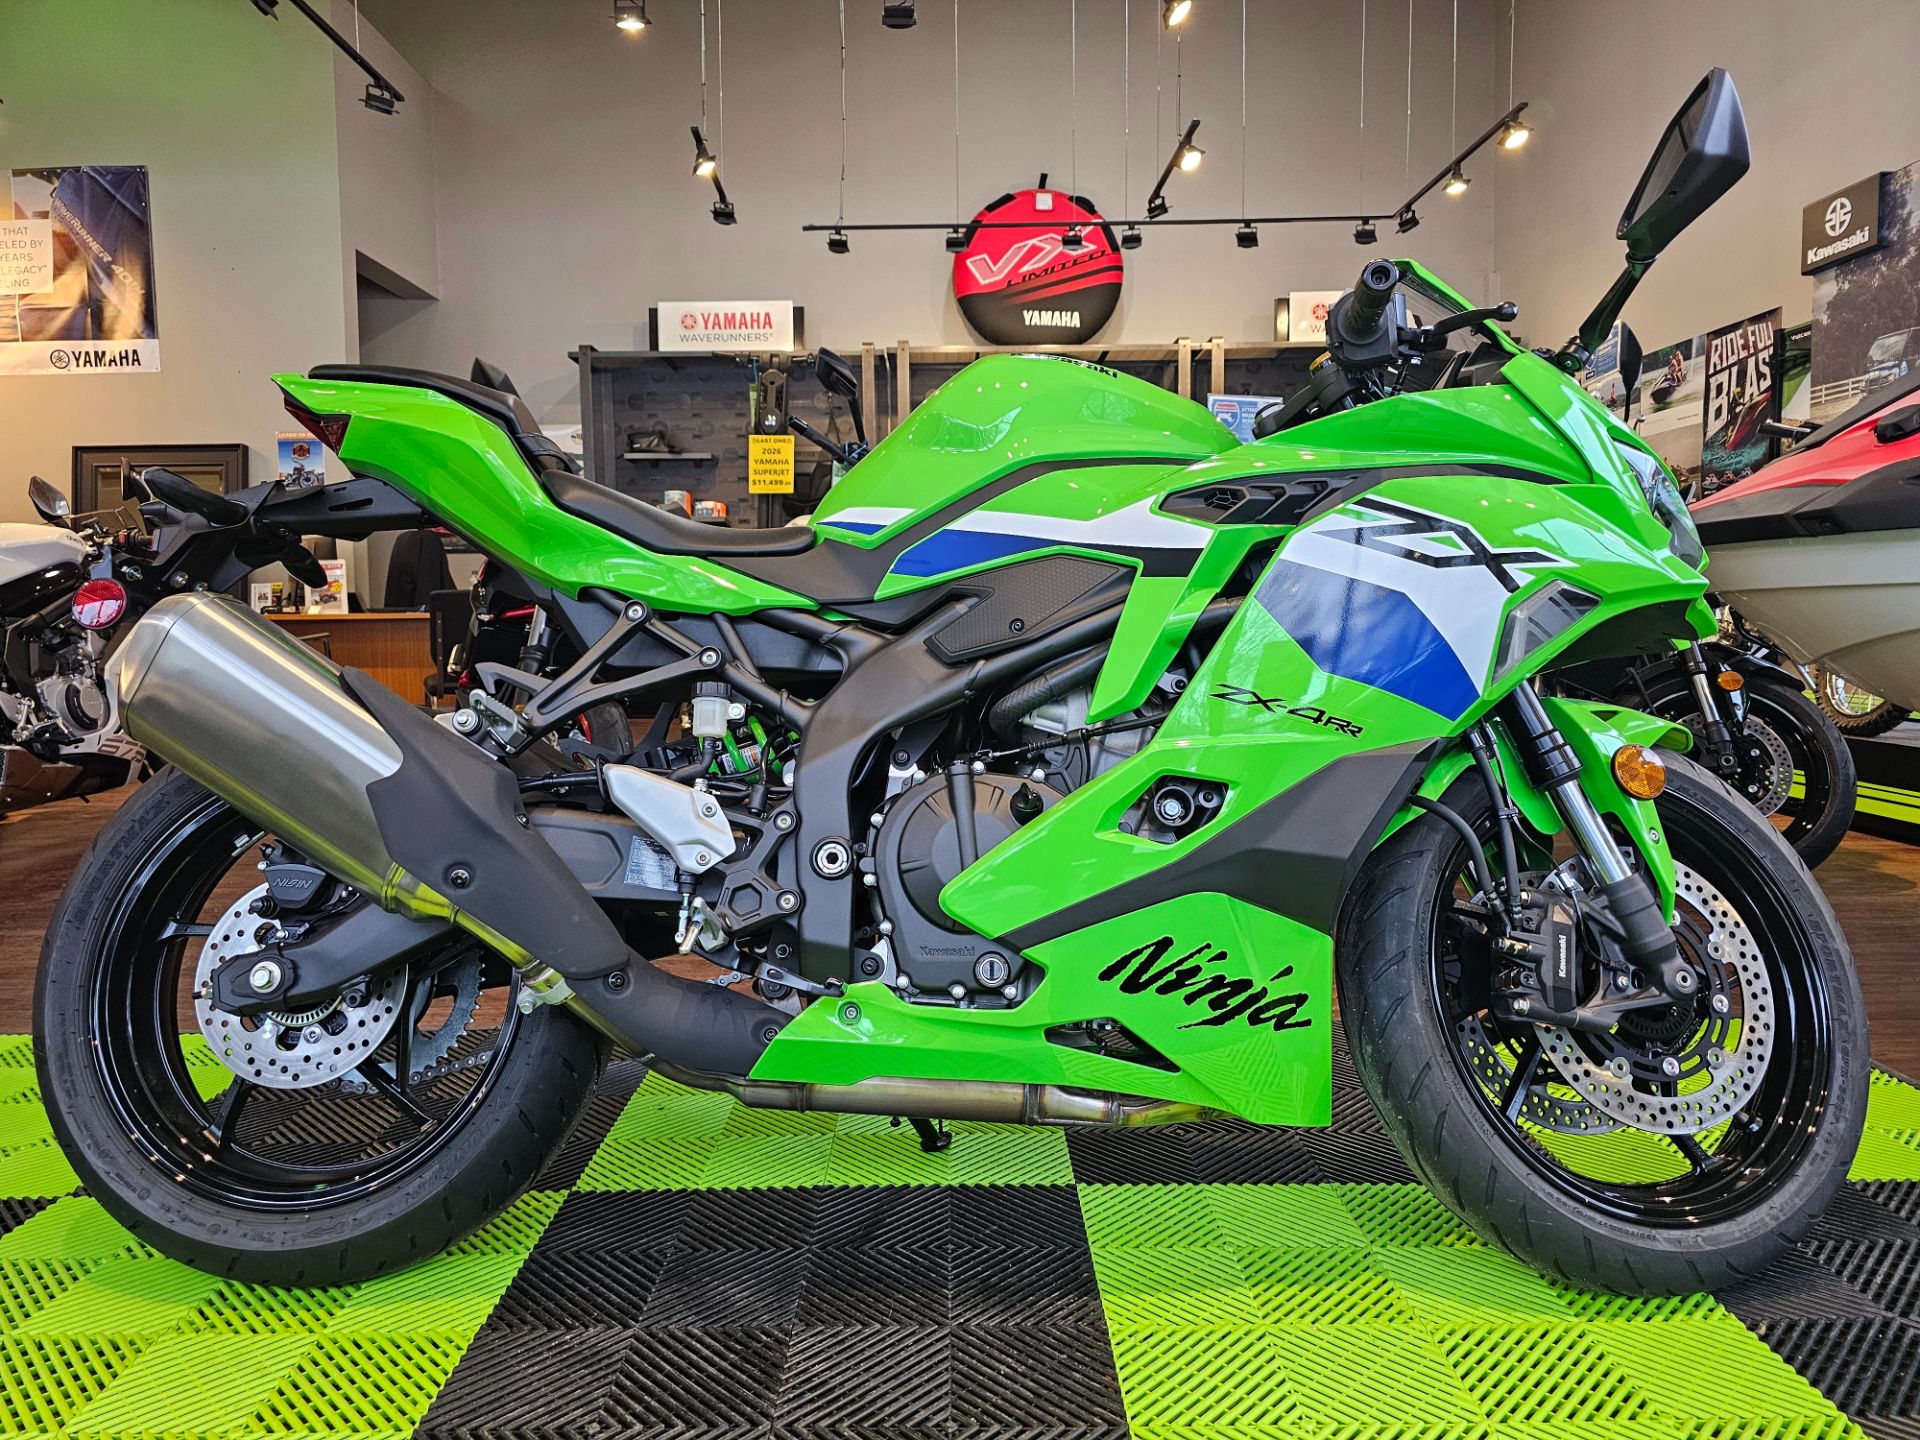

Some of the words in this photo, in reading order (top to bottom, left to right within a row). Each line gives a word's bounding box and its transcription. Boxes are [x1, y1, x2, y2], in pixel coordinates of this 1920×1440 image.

[2, 227, 29, 236] THAT
[30, 240, 44, 248] BY
[1807, 226, 1870, 264] Kawasaki
[966, 219, 1103, 285] VX
[1006, 250, 1107, 288] LIMITED
[701, 311, 773, 330] YAMAHA
[1022, 310, 1081, 328] YAMAHA
[71, 349, 142, 368] YAMAHA
[1708, 328, 1748, 376] RIDE
[1706, 345, 1774, 441] BLAS
[919, 945, 977, 957] Kawasaki
[1558, 934, 1567, 978] Kawasaki
[1098, 935, 1313, 1032] Ninja
